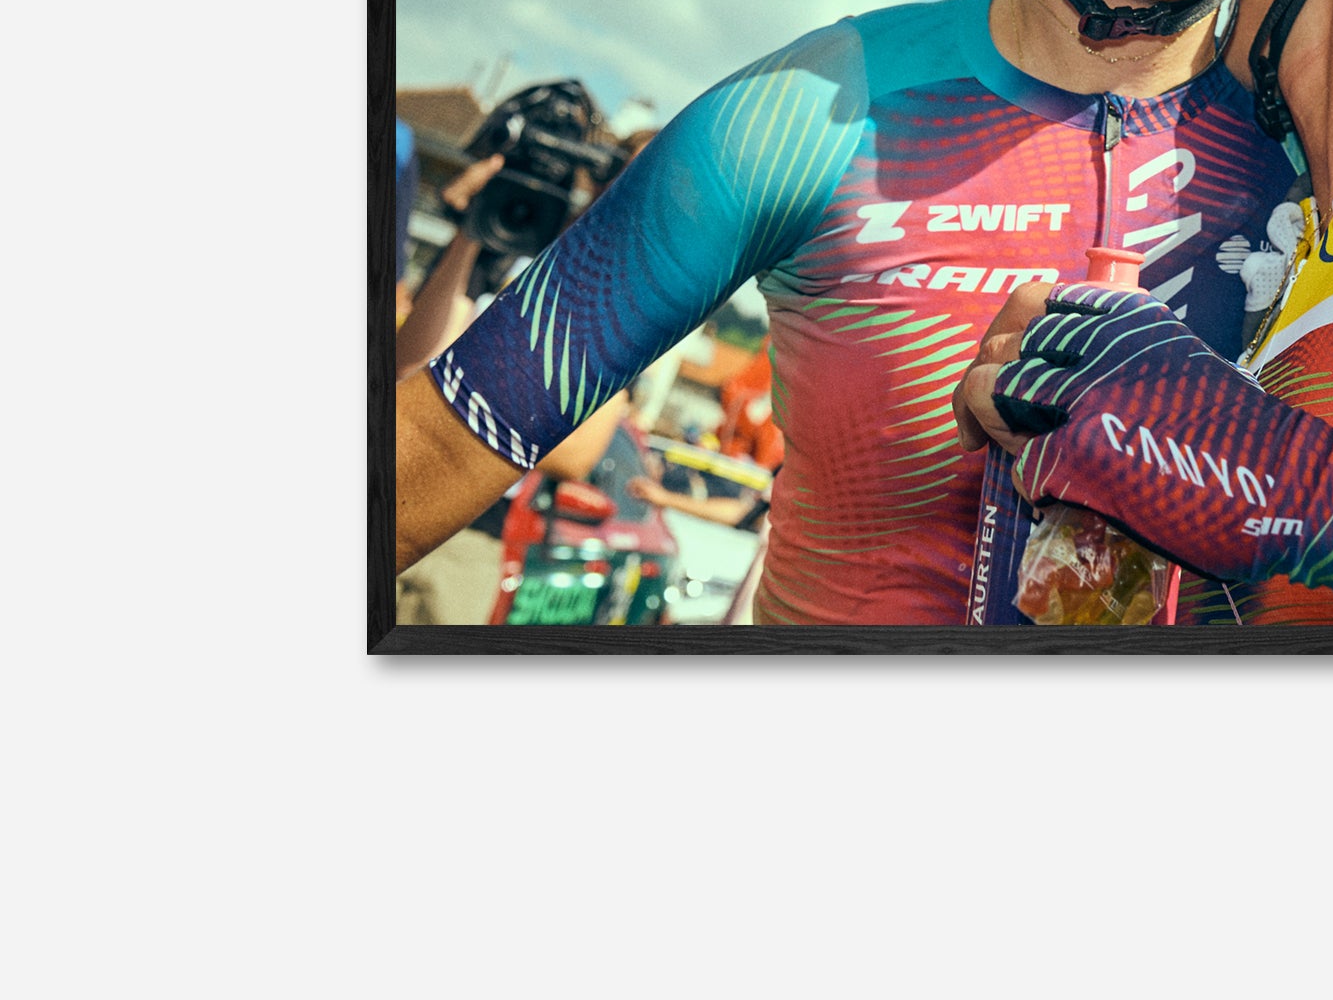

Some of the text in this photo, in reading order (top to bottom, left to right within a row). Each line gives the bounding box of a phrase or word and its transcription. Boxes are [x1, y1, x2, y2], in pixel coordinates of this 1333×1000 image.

[927, 204, 1070, 232] ZWIFT
[1101, 413, 1274, 507] CANYO
[973, 504, 998, 625] AURTEN
